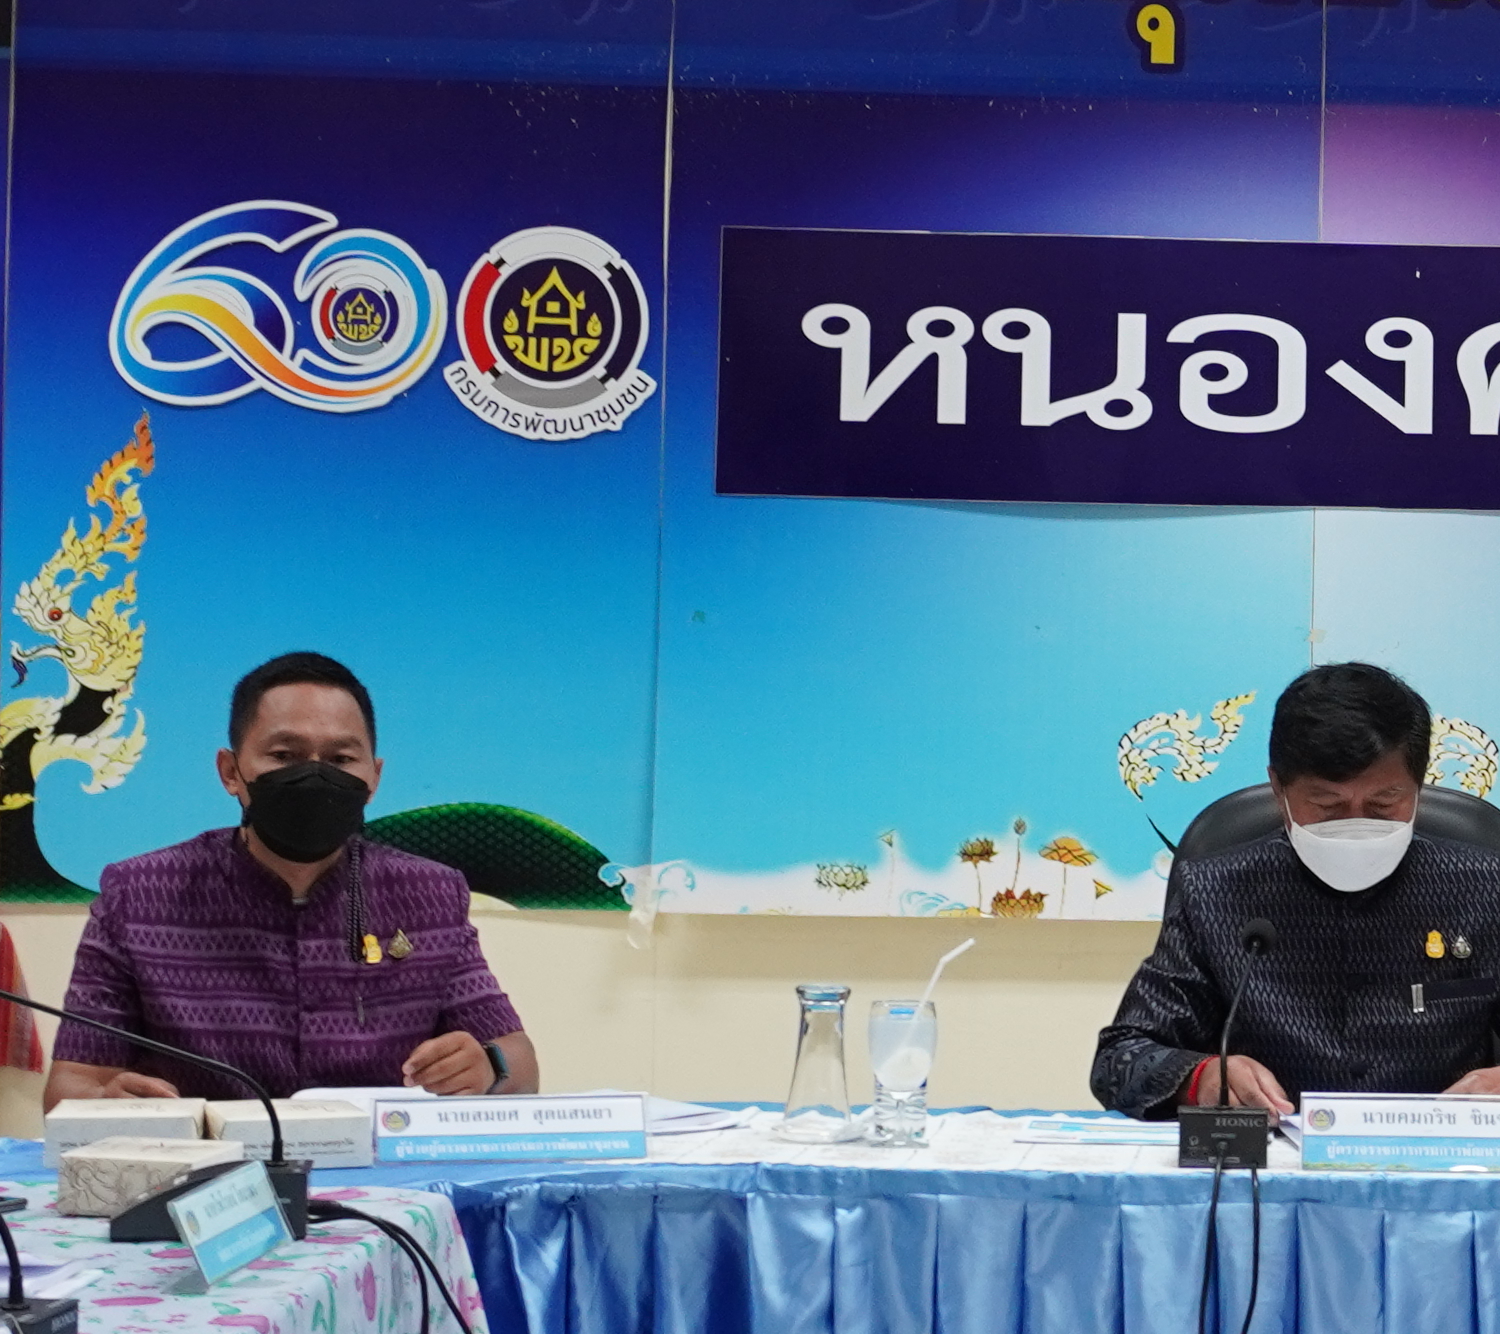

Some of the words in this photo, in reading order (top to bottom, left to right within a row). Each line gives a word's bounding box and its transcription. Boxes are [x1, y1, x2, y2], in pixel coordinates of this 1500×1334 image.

[450, 364, 651, 436] กรมการพัฒนาชุมชน
